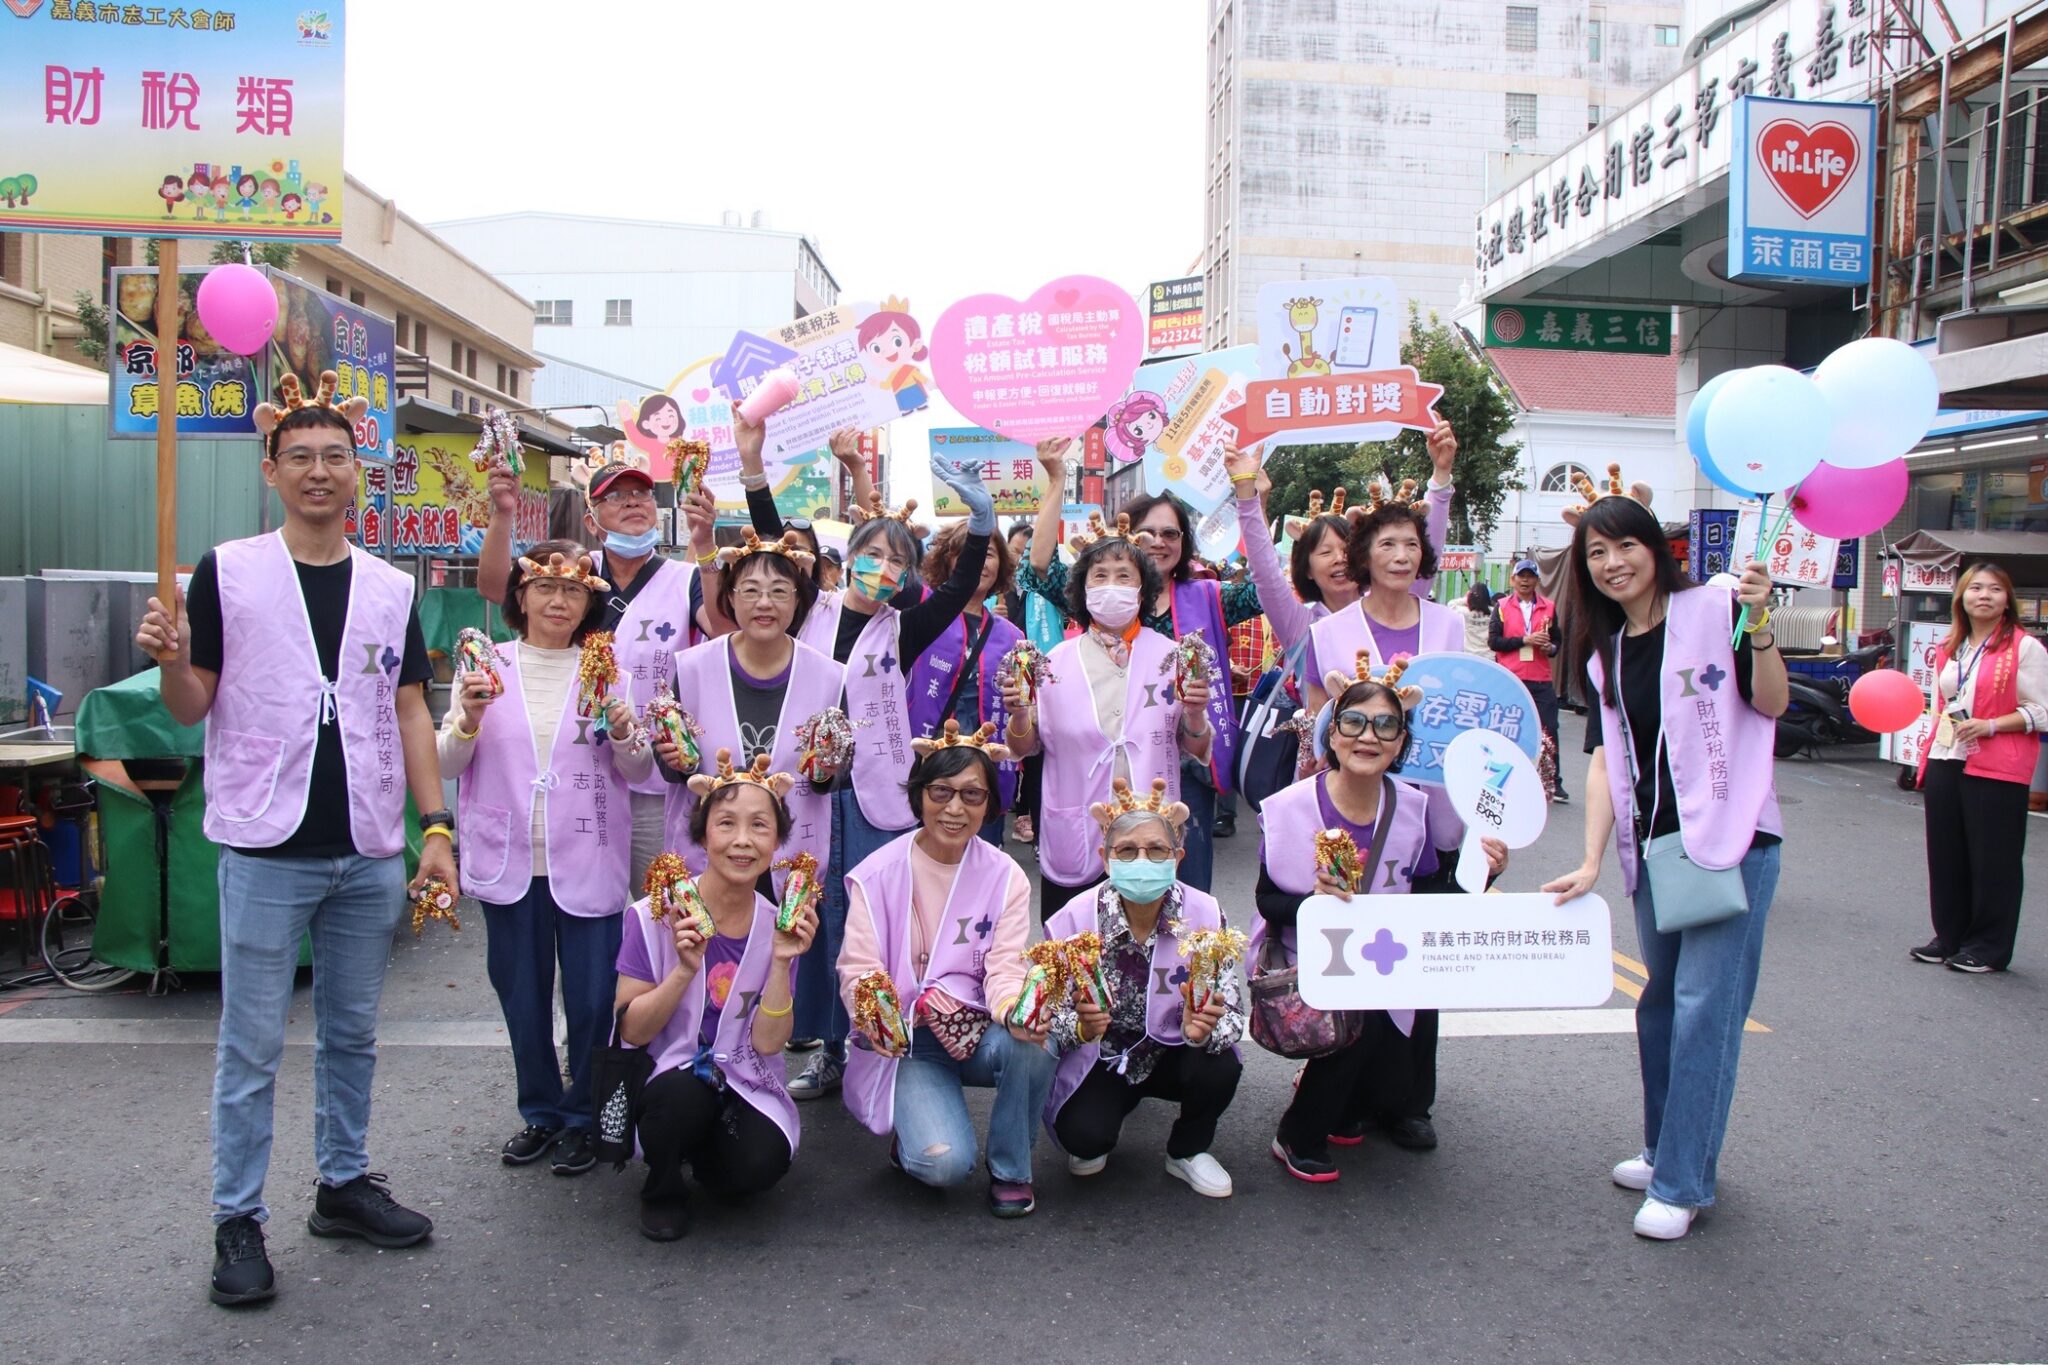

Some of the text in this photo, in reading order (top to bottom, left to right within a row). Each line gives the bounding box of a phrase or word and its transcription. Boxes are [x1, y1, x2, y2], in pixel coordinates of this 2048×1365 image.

[45, 64, 294, 136] 財稅類
[1750, 235, 1862, 274] 萊爾富
[964, 311, 1043, 340] 遺產稅
[1535, 312, 1662, 347] 嘉義三信
[963, 344, 1108, 374] 稅額試算服務
[1264, 382, 1404, 419] 自動對獎
[632, 663, 649, 719] 志工
[922, 677, 940, 739] 志工
[375, 680, 393, 794] 財政稅務局
[864, 700, 888, 757] 志工
[881, 683, 906, 766] 財政稅務局
[1421, 689, 1524, 742] 存雲端
[1696, 698, 1729, 801] 財政稅務局
[573, 771, 593, 834] 志工
[1476, 802, 1503, 826] EXPO
[1421, 929, 1591, 948] 嘉義市政府財政稅務局
[1422, 952, 1566, 962] FINANCE AND TAXATION BUREAU
[1422, 965, 1476, 973] CHIAYI CITY
